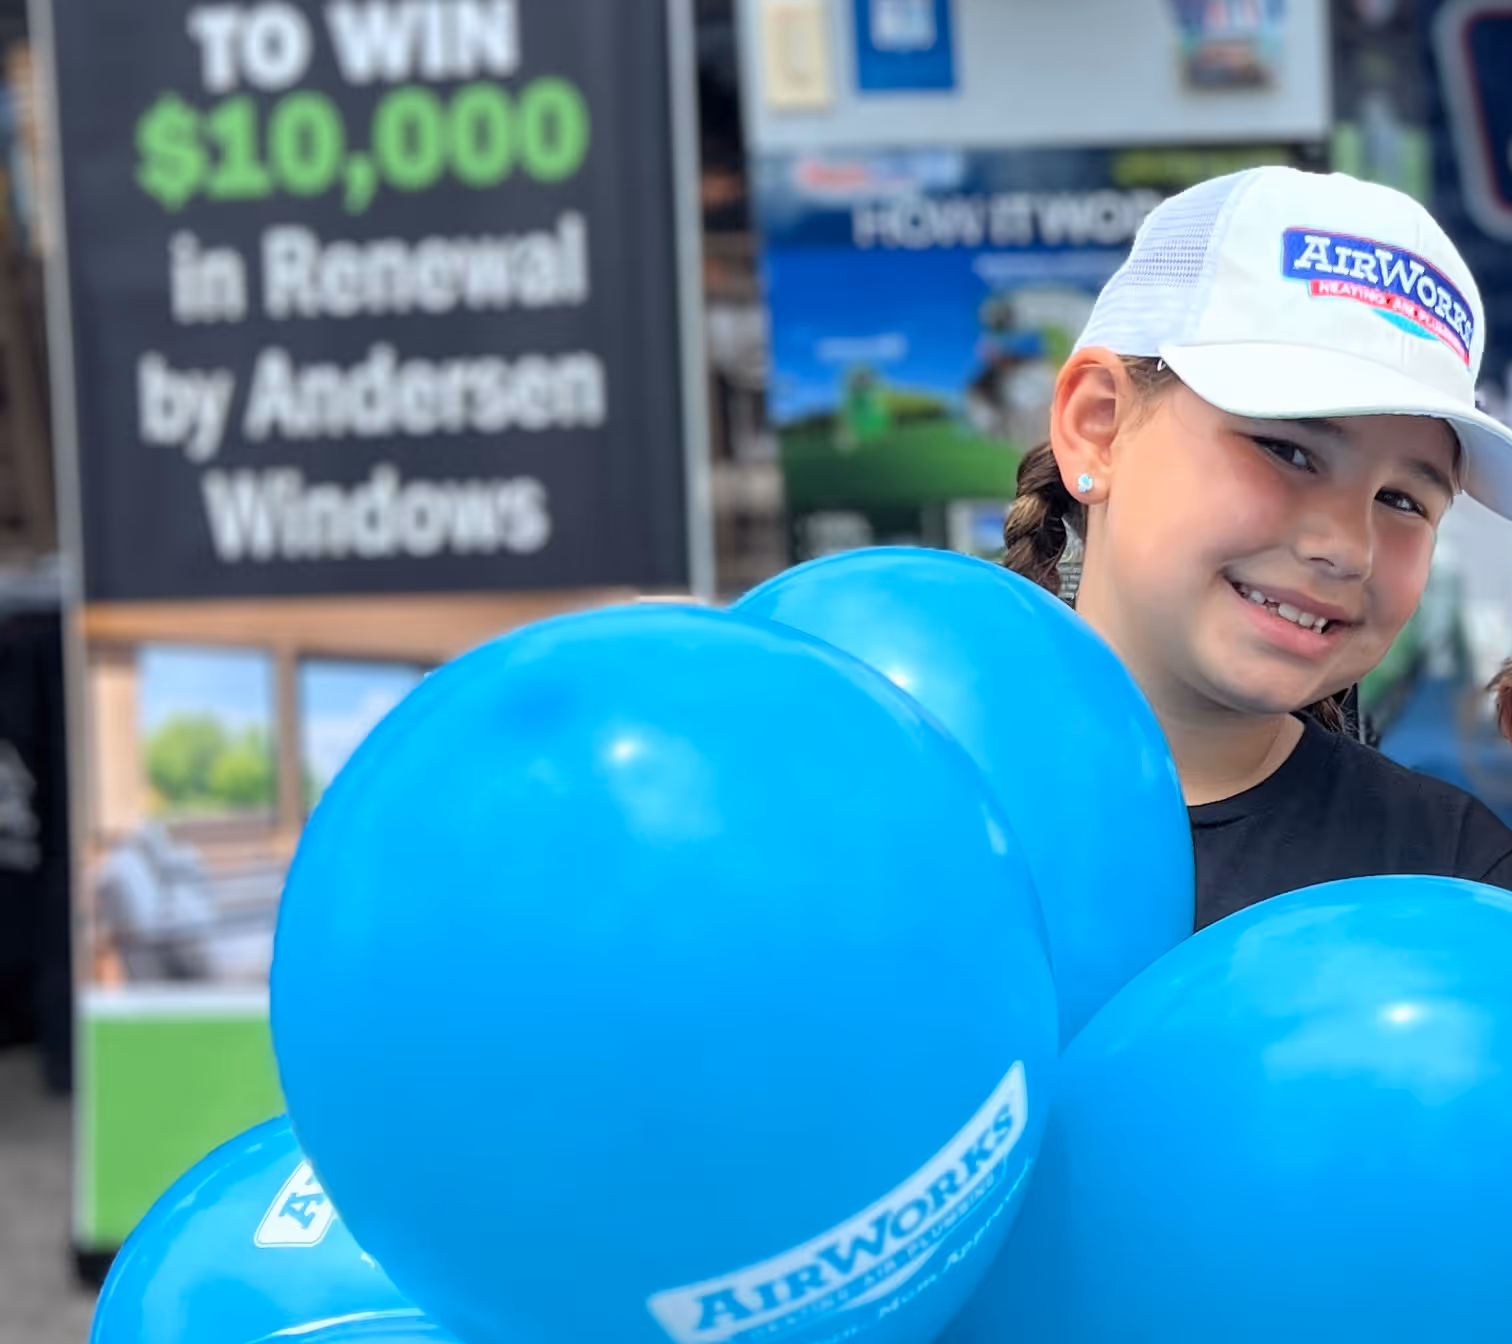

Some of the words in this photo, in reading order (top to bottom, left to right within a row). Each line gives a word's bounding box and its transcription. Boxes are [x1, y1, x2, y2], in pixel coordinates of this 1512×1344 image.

[189, 1, 311, 92] TO
[135, 77, 590, 215] $10,000
[170, 227, 246, 324] in
[262, 210, 589, 319] Renewal
[138, 350, 235, 462] by
[243, 343, 606, 441] Andersen
[202, 464, 552, 562] Windows
